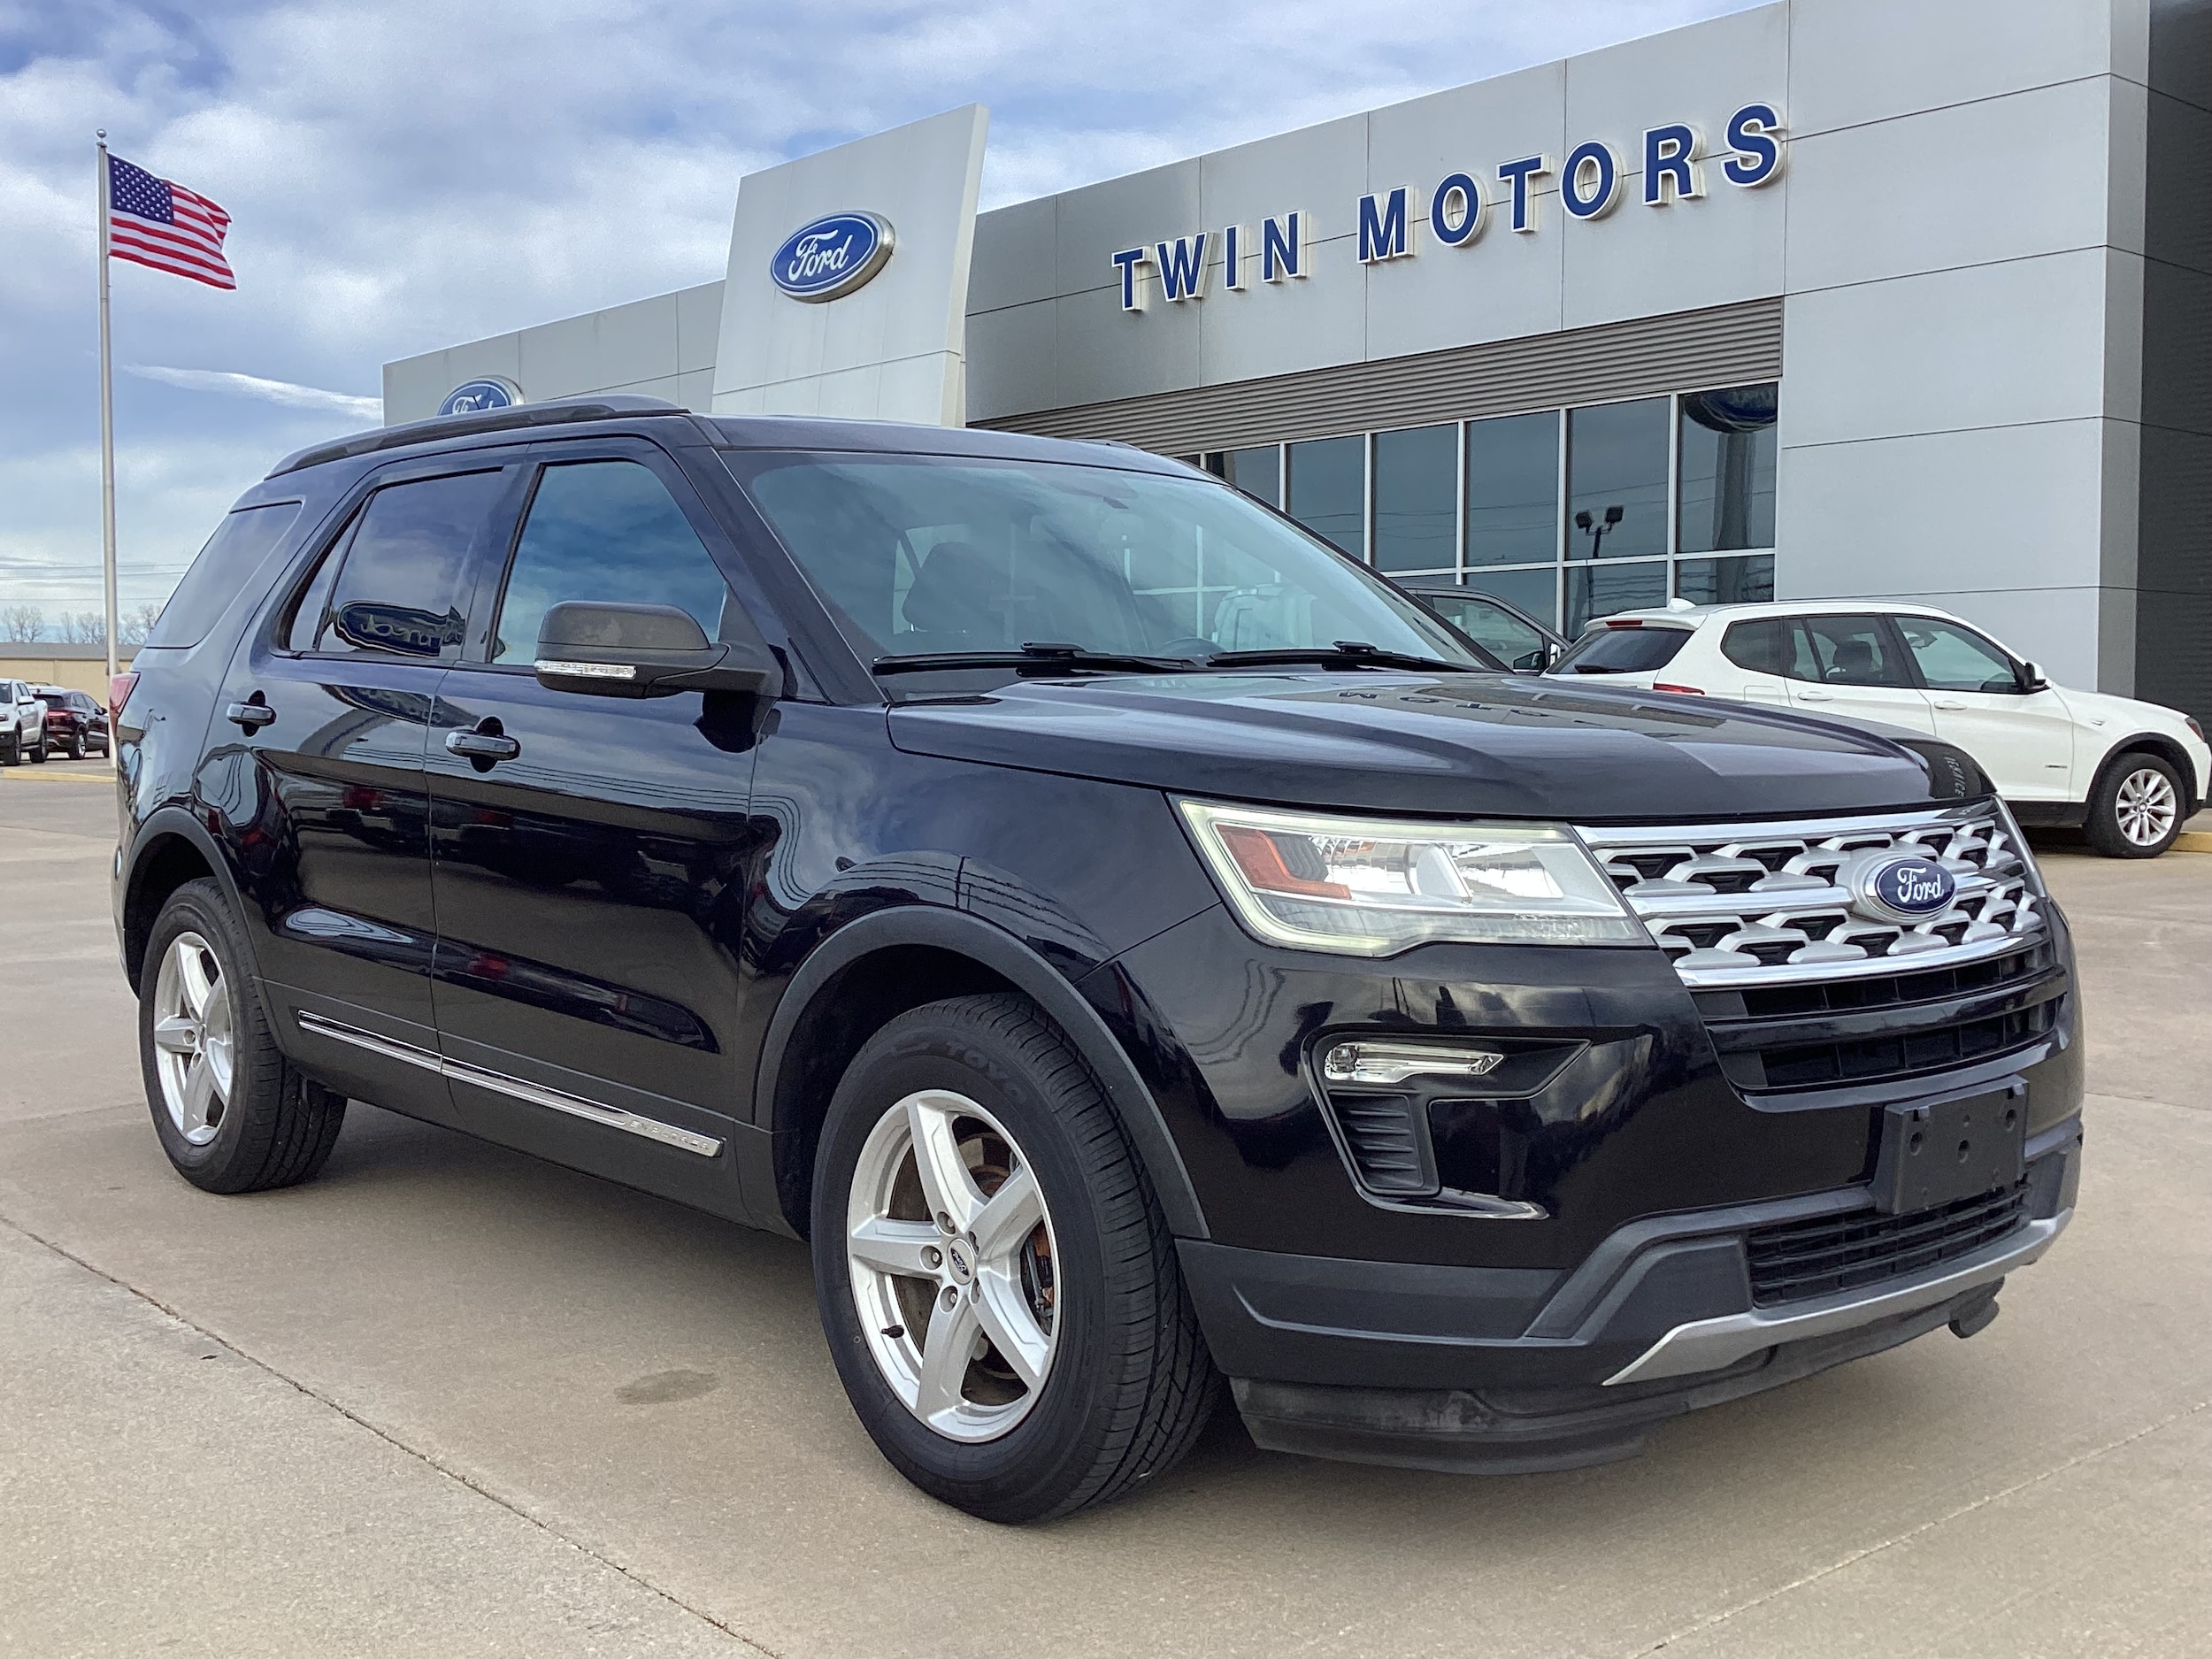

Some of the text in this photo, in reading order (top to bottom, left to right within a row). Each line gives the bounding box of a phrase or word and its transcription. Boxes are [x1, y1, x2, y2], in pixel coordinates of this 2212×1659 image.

[1111, 102, 1787, 311] TWIN MOTORS
[788, 229, 853, 281] Ford
[1897, 867, 1945, 903] Ford
